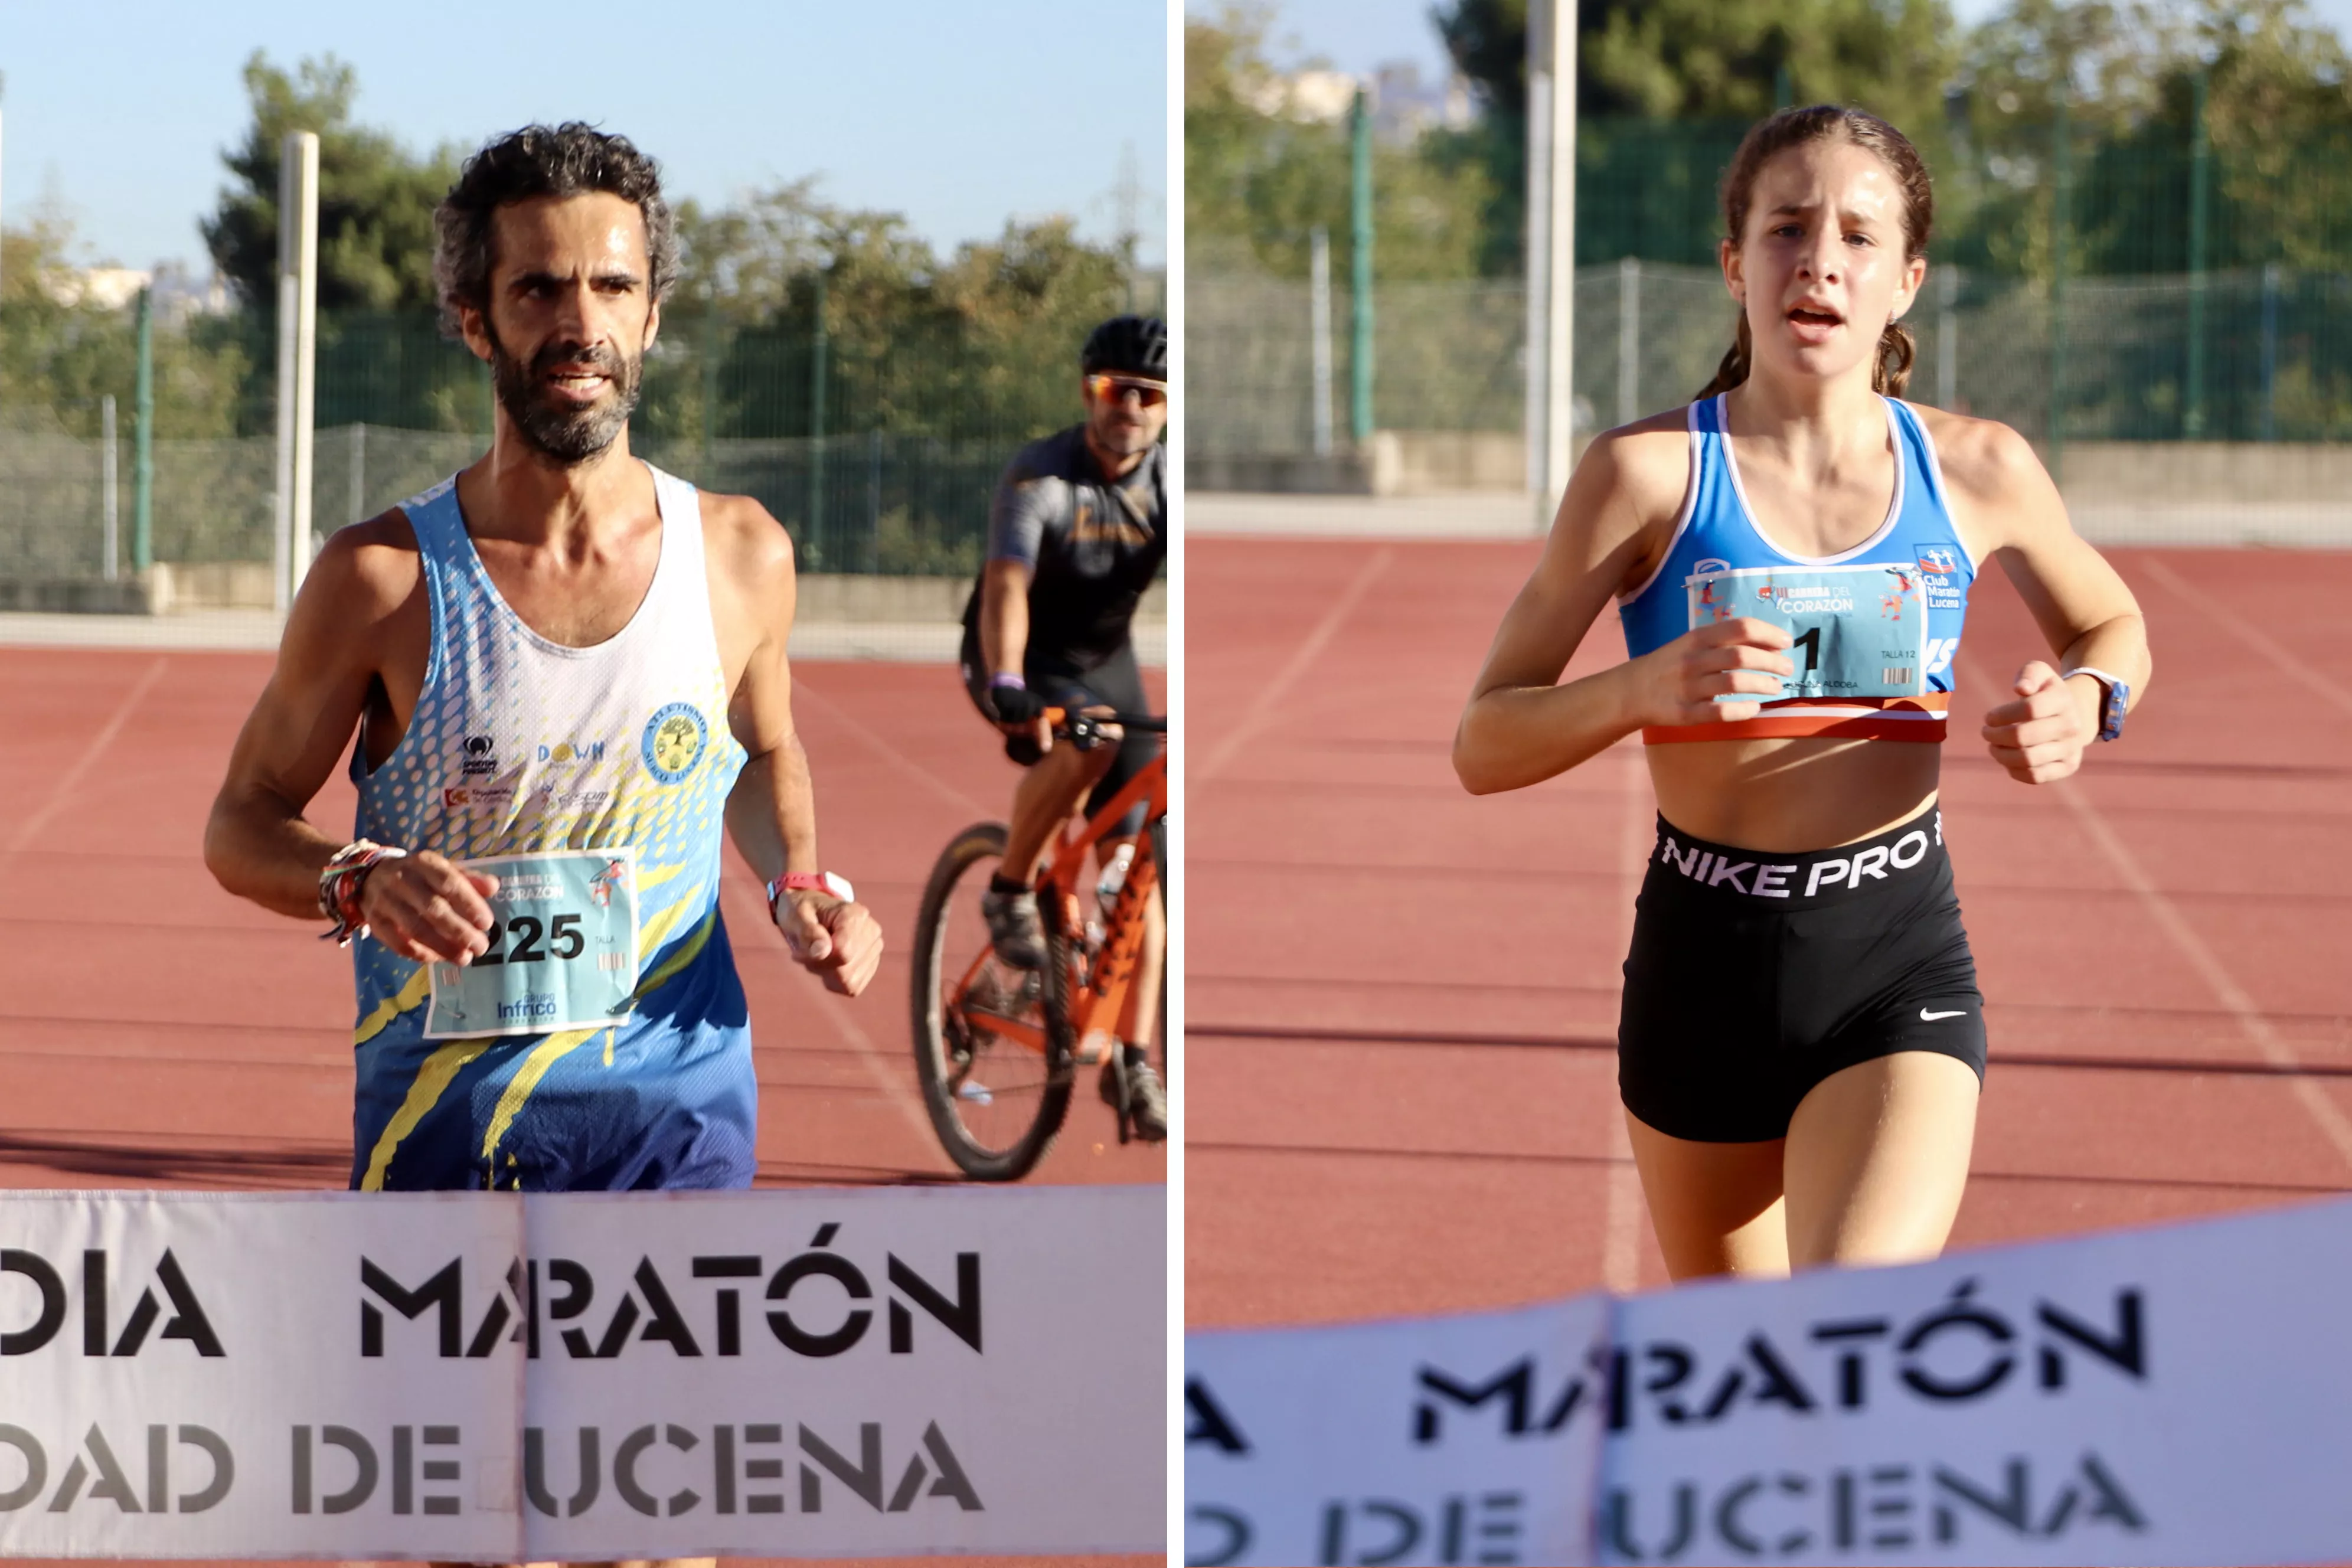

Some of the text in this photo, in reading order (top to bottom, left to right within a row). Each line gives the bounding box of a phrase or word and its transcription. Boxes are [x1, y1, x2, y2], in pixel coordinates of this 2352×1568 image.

[1832, 587, 1851, 596] DEL
[1924, 575, 1948, 586] Club
[1928, 586, 1961, 597] Maratón
[1929, 597, 1959, 609] Lucena
[1881, 650, 1915, 658] TALLA 12
[1661, 829, 1929, 898] NIKE PRO
[472, 913, 584, 966] 225
[498, 999, 556, 1019] Infrico
[361, 1223, 982, 1358] MARATÓN
[1413, 1276, 2149, 1446] MARATÓN
[291, 1425, 461, 1515] DE
[1322, 1494, 1523, 1568] DE
